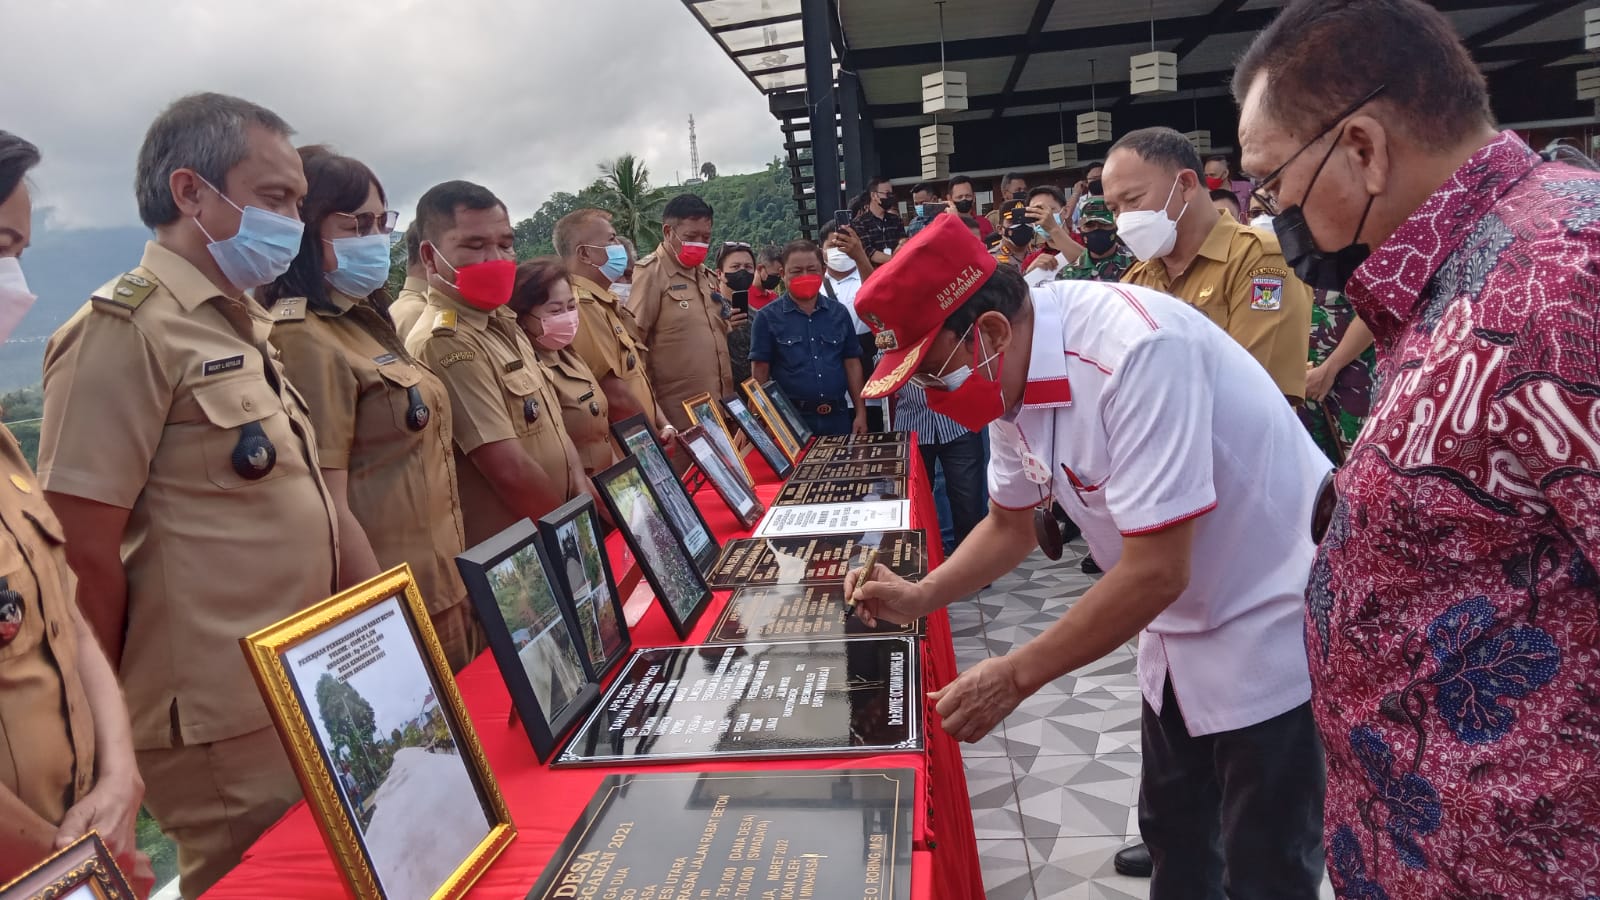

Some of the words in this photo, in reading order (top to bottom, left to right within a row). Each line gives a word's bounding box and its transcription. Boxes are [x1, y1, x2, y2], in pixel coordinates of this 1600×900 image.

[936, 265, 974, 301] BUPATI
[608, 698, 626, 711] APB
[617, 683, 636, 698] DESA
[609, 708, 634, 730] TAHUN
[624, 676, 655, 708] ANGGARAN
[711, 794, 731, 818] BETON
[608, 821, 634, 848] 2021
[700, 818, 721, 843] RABAT
[664, 856, 688, 884] UTARA
[690, 844, 711, 870] JALAN
[766, 855, 784, 881] MARET
[553, 850, 600, 898] DESA
[611, 867, 631, 885] DUA
[799, 857, 818, 897] MINAHASA
